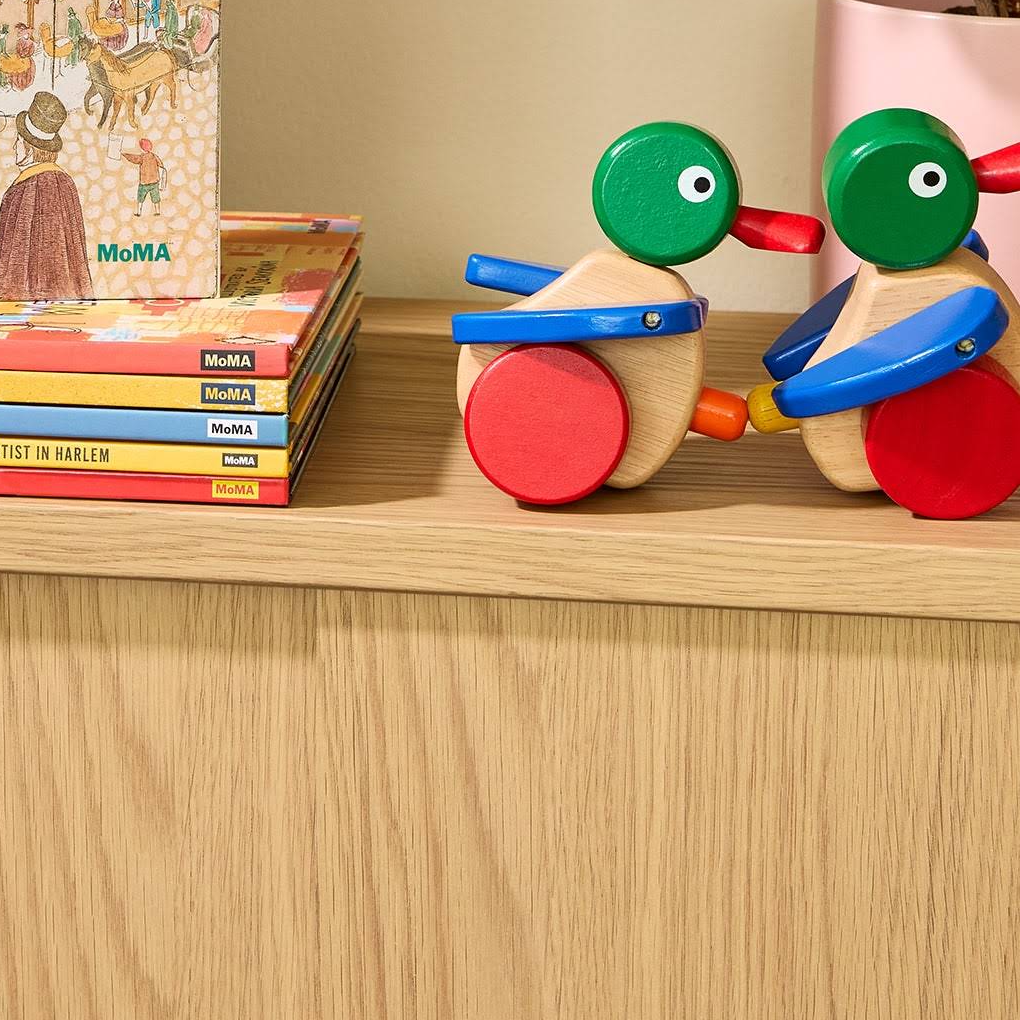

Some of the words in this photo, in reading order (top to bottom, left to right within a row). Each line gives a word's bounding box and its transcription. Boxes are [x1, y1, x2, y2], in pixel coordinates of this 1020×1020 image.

[97, 244, 171, 263] MoMA
[205, 353, 252, 368] MoMA
[204, 387, 252, 402] MoMA
[211, 422, 253, 436] MoMA
[36, 445, 50, 460] IN
[55, 446, 109, 464] HARLEM
[224, 455, 255, 466] MoMA
[215, 483, 254, 495] MoMA
